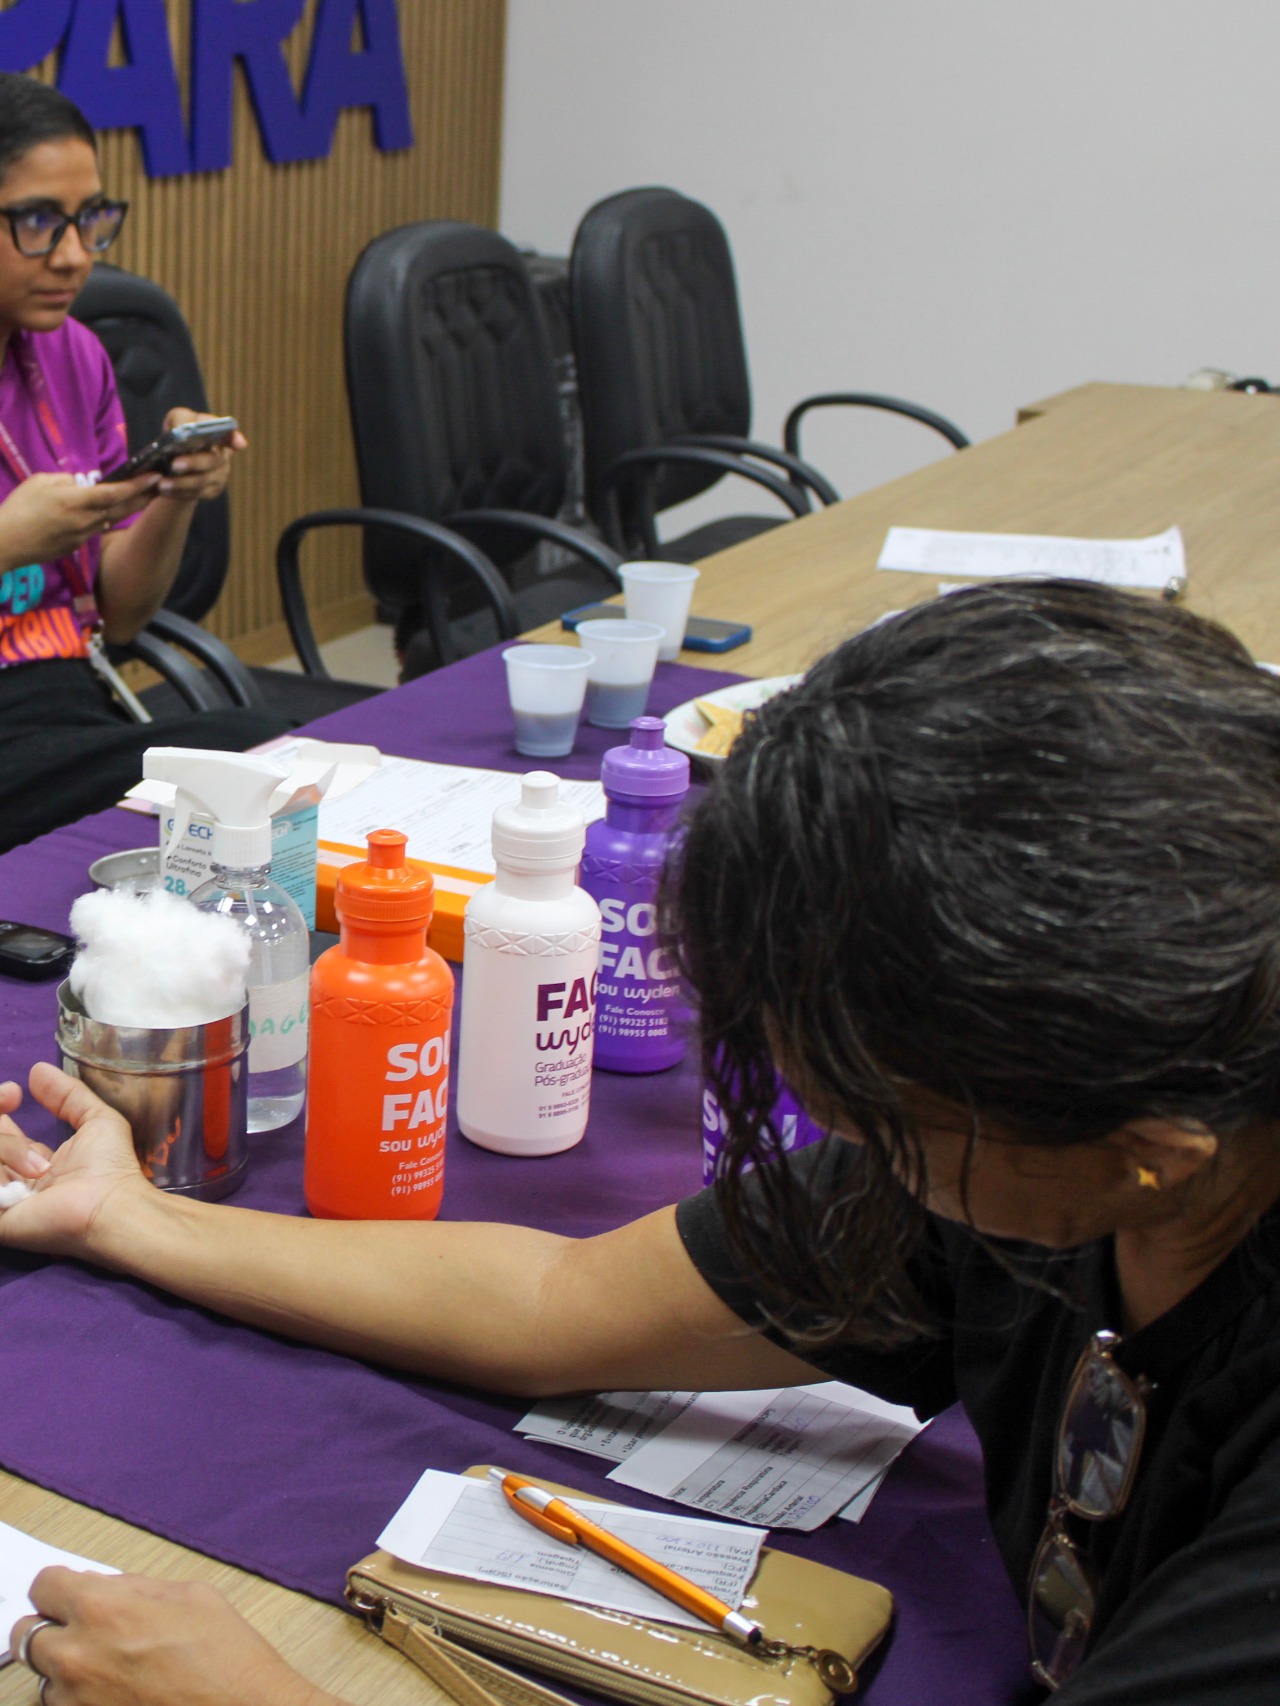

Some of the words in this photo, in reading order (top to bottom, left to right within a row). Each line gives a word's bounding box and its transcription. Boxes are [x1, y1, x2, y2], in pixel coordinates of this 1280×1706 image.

[164, 875, 186, 896] 28
[604, 1004, 624, 1015] Fale
[599, 1014, 617, 1026] (91)
[598, 1025, 617, 1037] (91)
[398, 1160, 418, 1171] Fale
[392, 1172, 412, 1185] (91)
[391, 1184, 411, 1197] (91)
[624, 1436, 640, 1451] Usar
[663, 1544, 705, 1557] Arterial
[728, 1544, 754, 1557] (PA):
[705, 1550, 751, 1565] Pressão
[529, 1562, 577, 1578] Glicemia
[722, 1562, 748, 1573] (FC):
[513, 1573, 569, 1592] Saturação
[713, 1576, 739, 1588] (FR):
